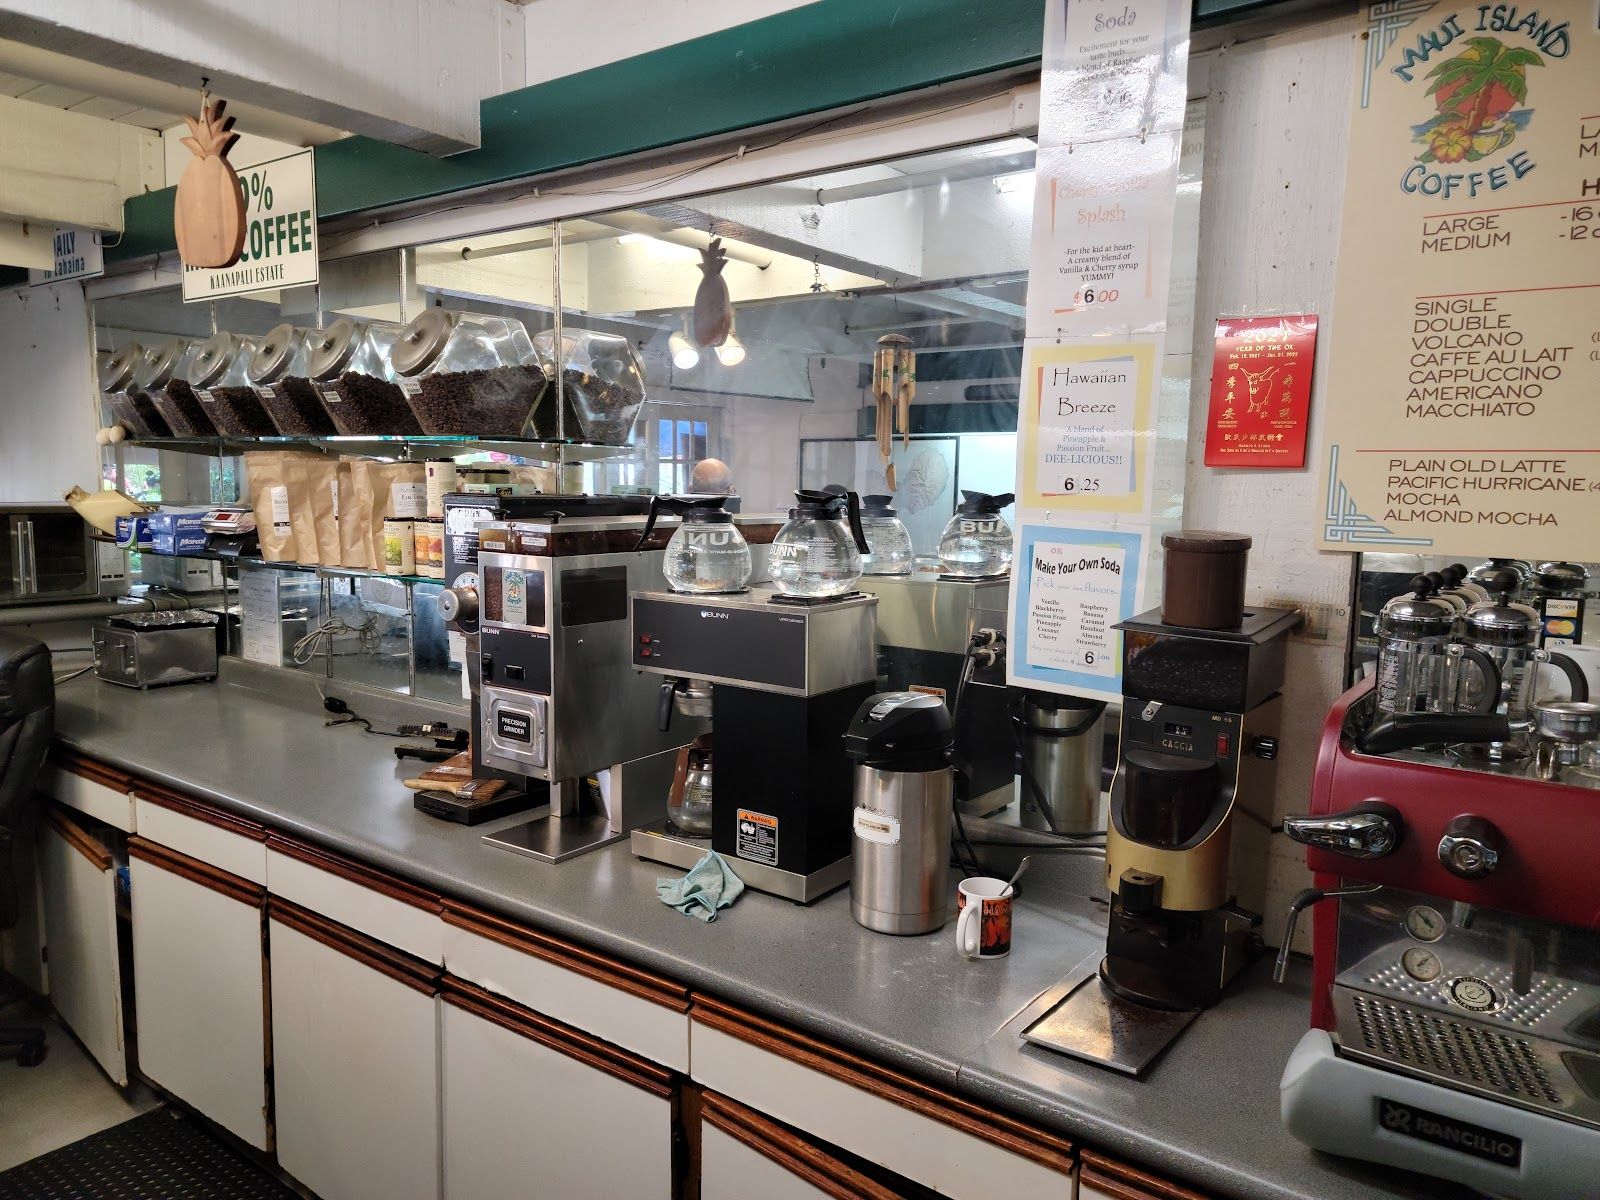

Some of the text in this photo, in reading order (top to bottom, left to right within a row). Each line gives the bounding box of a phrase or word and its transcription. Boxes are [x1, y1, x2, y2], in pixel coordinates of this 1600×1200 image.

[1094, 7, 1136, 32] Soda
[1079, 40, 1118, 53] Excitement
[1132, 35, 1149, 45] your
[1391, 4, 1570, 82] MAUI ISLAND
[1090, 53, 1107, 61] taste
[1401, 150, 1537, 200] COFFEE
[1077, 203, 1126, 227] Splash
[1422, 215, 1500, 236] LARGE
[1080, 246, 1090, 254] the
[1092, 245, 1103, 253] kid
[1421, 232, 1511, 254] MEDIUM
[1074, 256, 1100, 266] creamy
[1101, 253, 1122, 262] blend
[1123, 252, 1132, 260] of
[54, 257, 85, 277] Lahaina
[1059, 266, 1083, 274] Vanilla
[1091, 263, 1117, 274] Cherry
[1118, 262, 1139, 271] syrup
[210, 263, 285, 289] KAANAPALI ESTATE
[1414, 297, 1498, 316] SINGLE
[1413, 314, 1512, 333] DOUBLE
[1412, 331, 1523, 350] VOLCANO
[1410, 351, 1481, 367] CAFFE
[1484, 349, 1517, 365] AU
[1522, 347, 1574, 363] LAIT
[1053, 367, 1126, 387] Hawaiian
[1409, 365, 1562, 384] CAPPUCCINO
[1406, 383, 1543, 402] AMERICANO
[1057, 397, 1116, 416] Breeze
[1406, 402, 1536, 418] MACCHIATO
[1096, 425, 1104, 433] of
[1063, 435, 1099, 444] Pineapple
[1045, 454, 1123, 465] DEE-LICIOUS!!
[1389, 459, 1566, 473] PLAIN OLD LATTE
[1387, 476, 1459, 489] PACIFIC
[1463, 477, 1586, 492] HURRICANE
[1386, 492, 1461, 506] MOCHA
[1383, 509, 1558, 527] ALMOND MOCHA
[180, 537, 206, 545] Marcal
[1050, 547, 1063, 555] OR
[1035, 557, 1121, 575] Make Your Own Soda
[1035, 604, 1065, 614] Blackberry
[1041, 598, 1059, 606] Vanilla
[1079, 603, 1109, 612] Raspberry
[706, 611, 729, 619] BUNN
[1032, 611, 1051, 619] Passion
[1081, 618, 1105, 626] Caramel
[1036, 619, 1062, 628] Pineapple
[1080, 625, 1105, 633] Hazelnut
[481, 627, 500, 635] BUNN
[1038, 633, 1058, 642] Cherry
[1081, 632, 1103, 640] Almond
[1076, 638, 1107, 648] Strawberry
[502, 717, 527, 728] PRECISION
[503, 726, 525, 735] GRINDER
[750, 815, 772, 825] WARNING
[1415, 1117, 1514, 1158] RANCILIO
